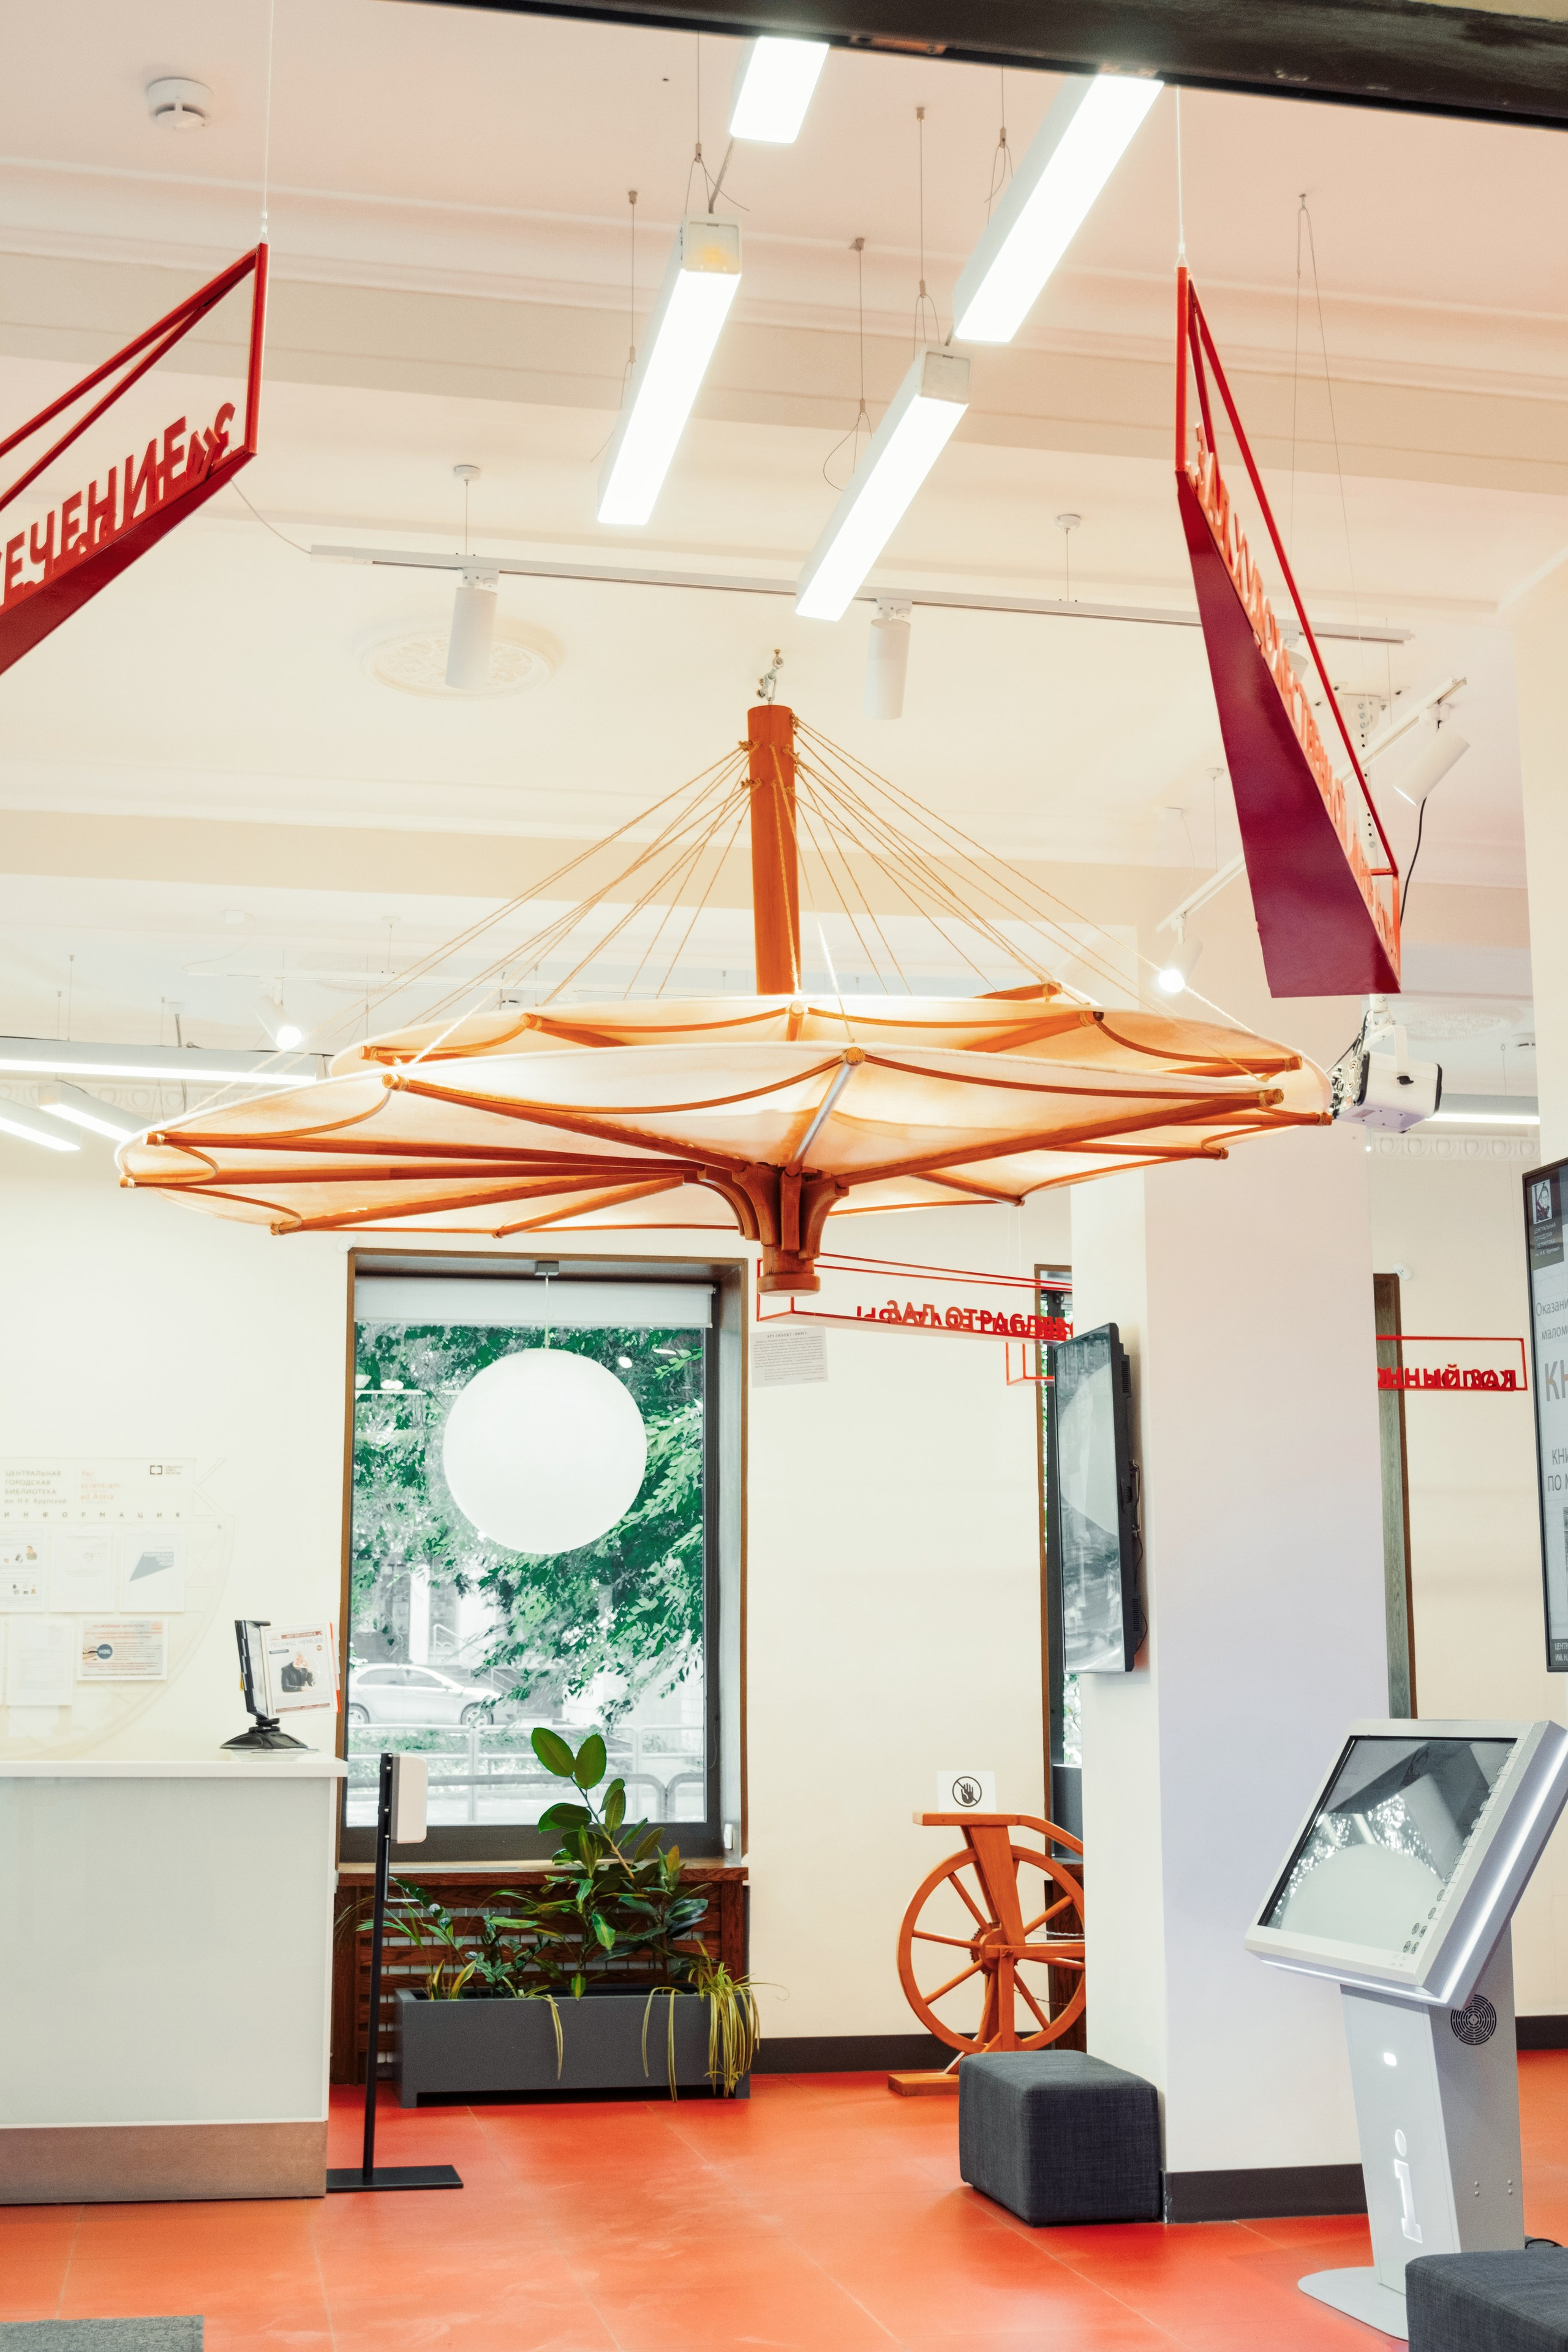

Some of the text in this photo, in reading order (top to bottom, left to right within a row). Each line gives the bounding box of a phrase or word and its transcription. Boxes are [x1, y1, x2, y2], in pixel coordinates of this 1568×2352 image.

[0, 415, 186, 608] ЕЧЕНИЕ
[1542, 1325, 1568, 1341] малом
[1548, 1474, 1561, 1492] ПО
